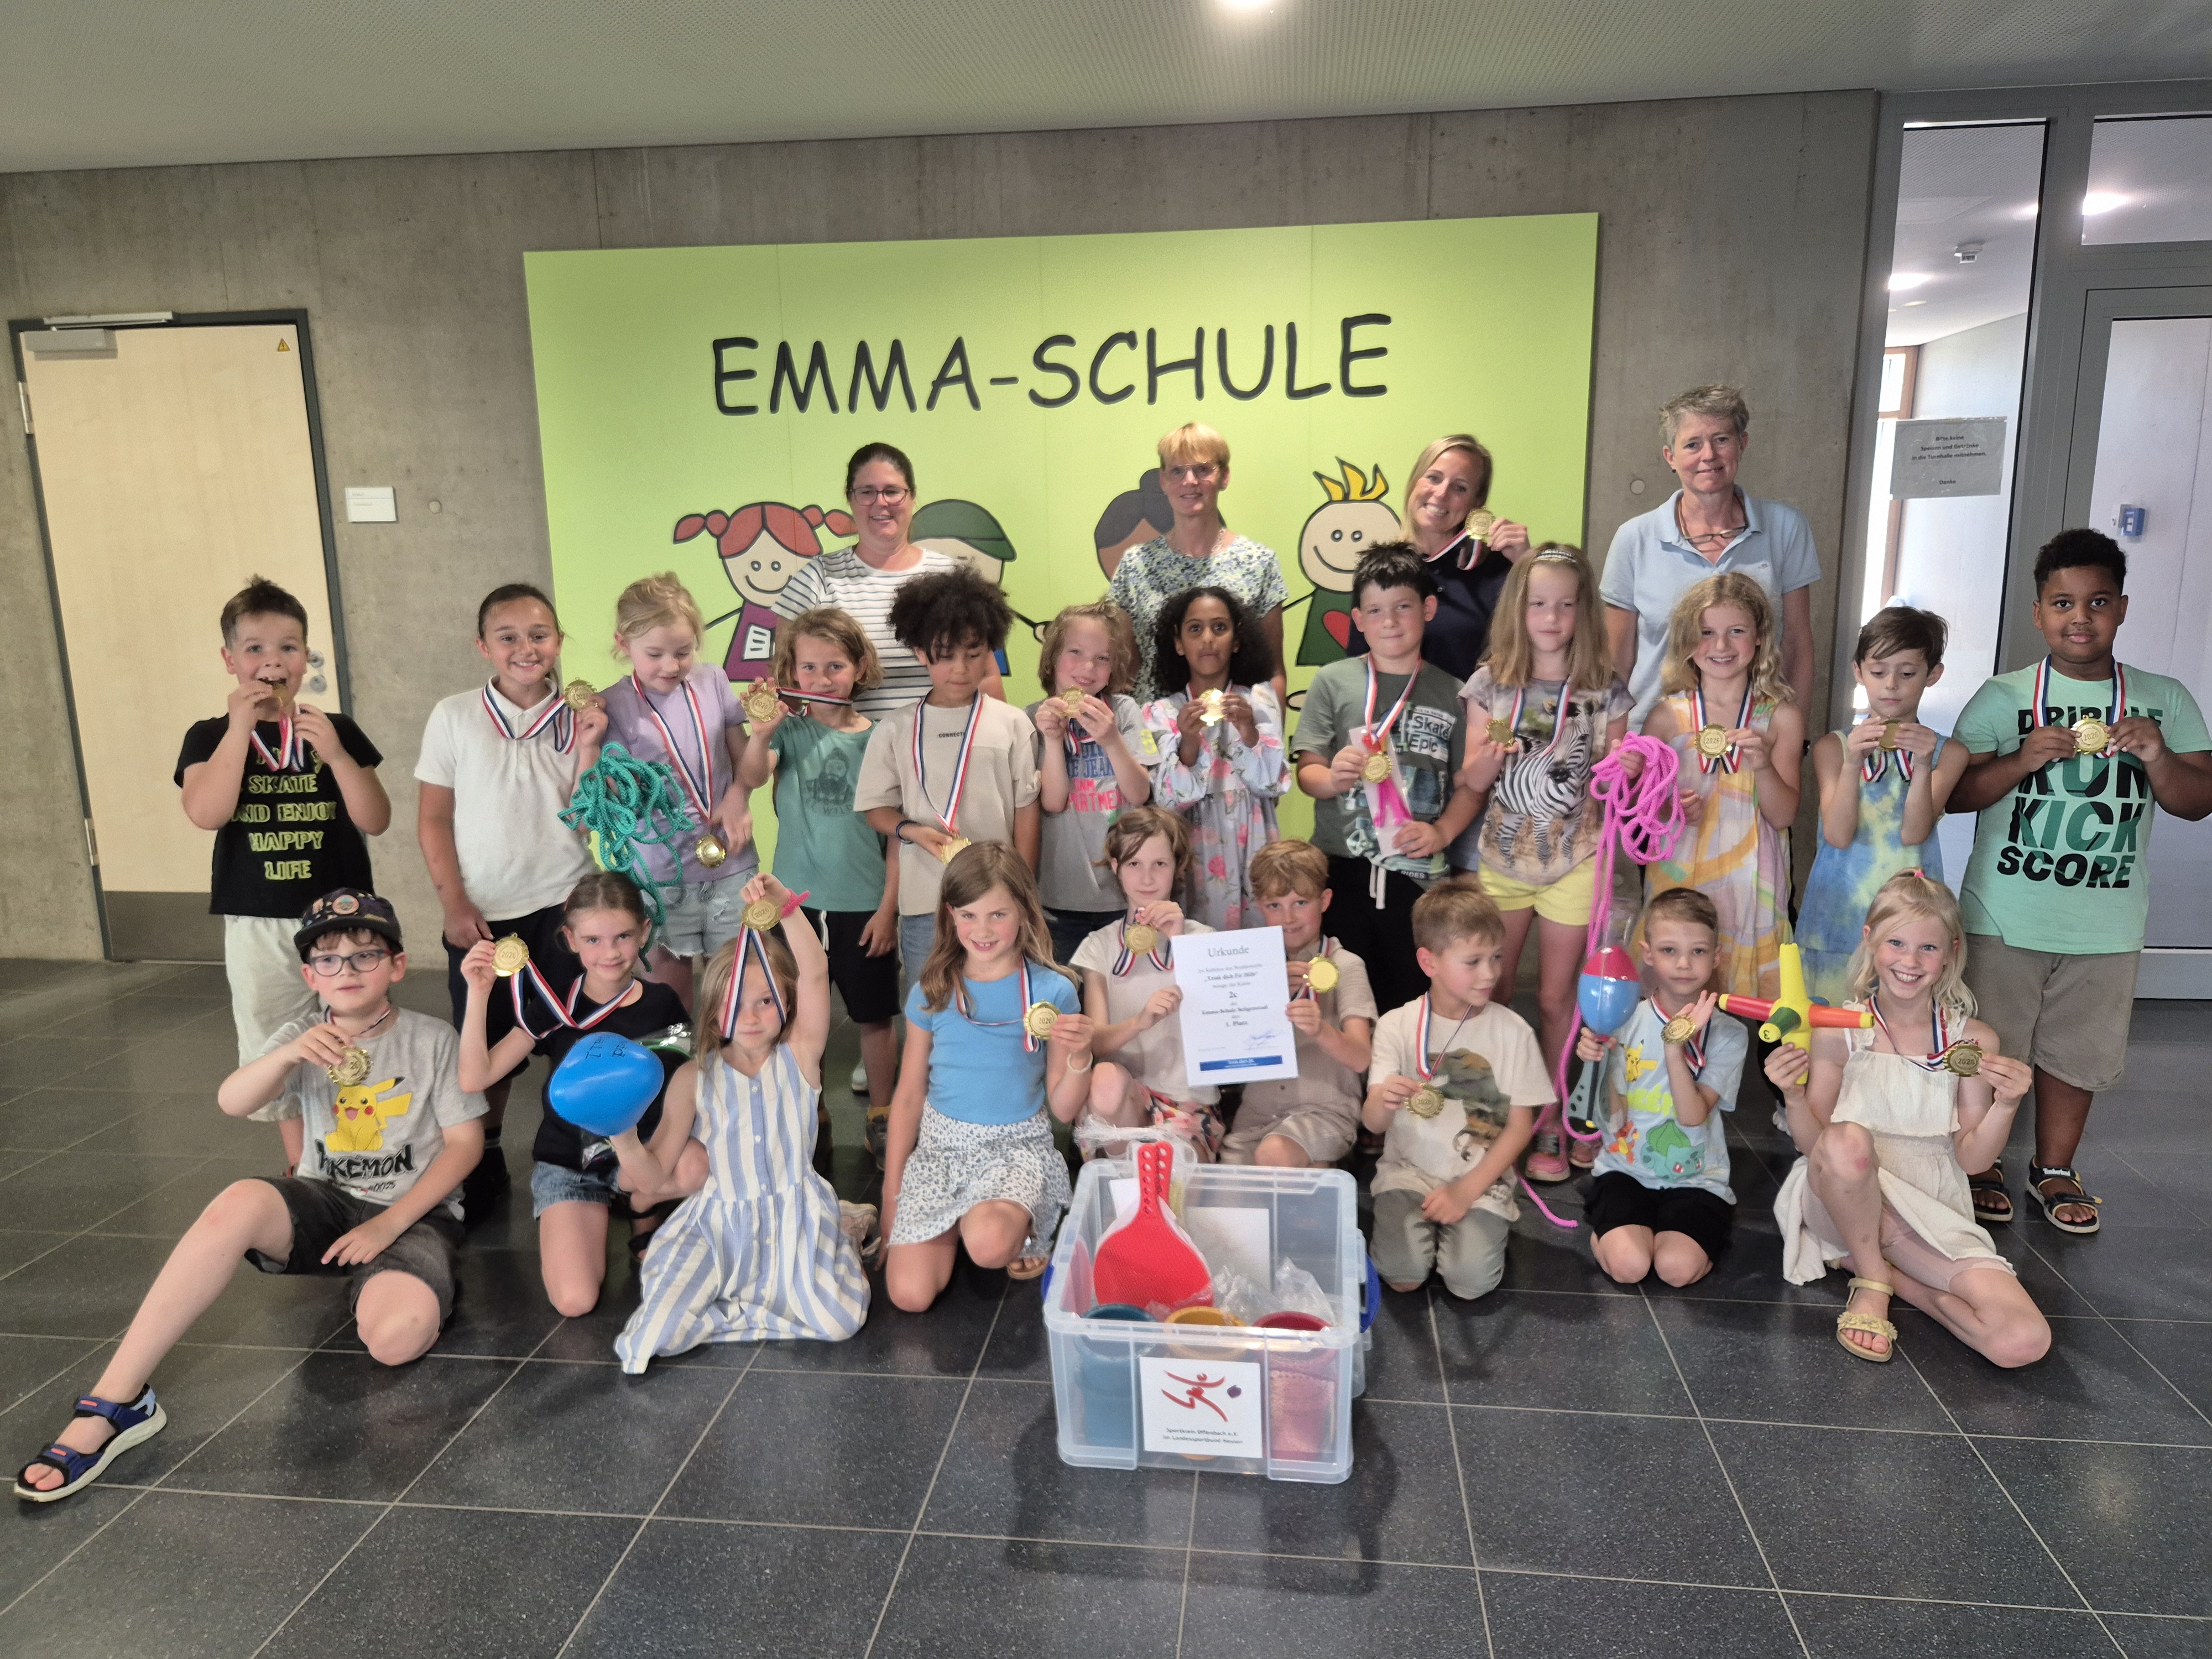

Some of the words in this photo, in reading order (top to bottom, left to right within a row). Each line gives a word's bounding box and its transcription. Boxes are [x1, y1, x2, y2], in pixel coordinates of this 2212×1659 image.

[713, 314, 1391, 414] EMMA-SCHULE
[1410, 734, 1438, 753] Epic
[249, 774, 318, 794] SKATE
[2008, 796, 2146, 853] KICK
[248, 831, 324, 852] HAPPY
[264, 860, 312, 880] LIFE
[1997, 846, 2135, 888] SCORE
[1208, 946, 1250, 957] Urkunde
